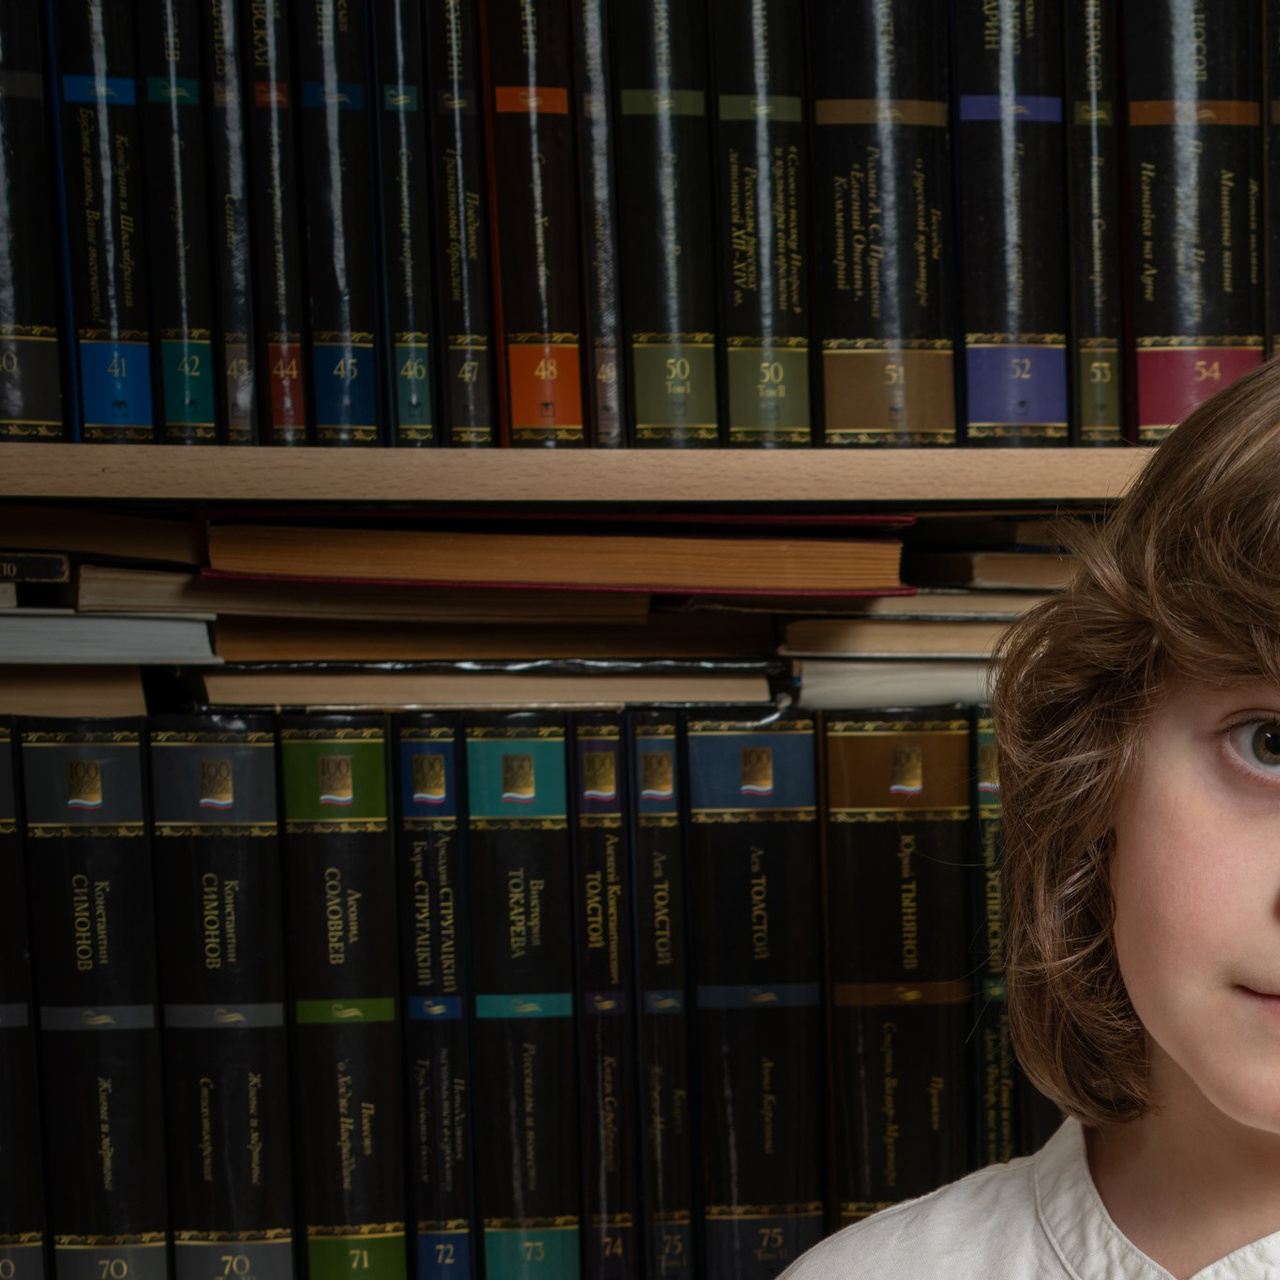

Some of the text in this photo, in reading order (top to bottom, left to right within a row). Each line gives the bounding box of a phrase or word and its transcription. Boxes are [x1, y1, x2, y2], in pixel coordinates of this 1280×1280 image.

[466, 191, 479, 260] Поединок
[1139, 162, 1157, 302] Незнайка на Луне
[106, 363, 127, 379] 41
[176, 359, 201, 378] 42
[272, 359, 299, 380] 44
[400, 362, 427, 380] 46
[457, 361, 479, 382] 47
[533, 360, 558, 380] 48
[665, 358, 690, 381] 50
[758, 362, 784, 385] 50
[883, 364, 904, 385] 51
[1009, 358, 1032, 380] 52
[1193, 360, 1221, 382] 54
[506, 868, 527, 959] ТОКАРЕВА
[527, 879, 544, 947] Виктория
[585, 871, 606, 949] ТОЛСТОЙ
[605, 834, 624, 985] Алексей Константинович
[652, 851, 675, 966] Лев ТОЛСТОЙ
[749, 846, 772, 960] Лев ТОЛСТОЙ
[71, 874, 92, 971] СИМОНОВ
[92, 880, 112, 965] Константин
[199, 873, 221, 970] СИМОНОВ
[222, 879, 240, 963] Константин
[324, 867, 347, 966] СОЛОВЬЕВ
[346, 889, 362, 944] Леонид
[900, 881, 919, 969] ТЫНЯНОВ
[415, 880, 435, 986] СТРУГАЦКИЙ
[438, 887, 459, 994] СТРУГАЦКИЙ
[603, 1237, 623, 1258] 74
[758, 1228, 784, 1248] 75
[348, 1249, 369, 1270] 71
[435, 1244, 456, 1265] 72
[523, 1241, 546, 1261] 73
[97, 1259, 128, 1280] 70
[220, 1254, 251, 1276] 70
